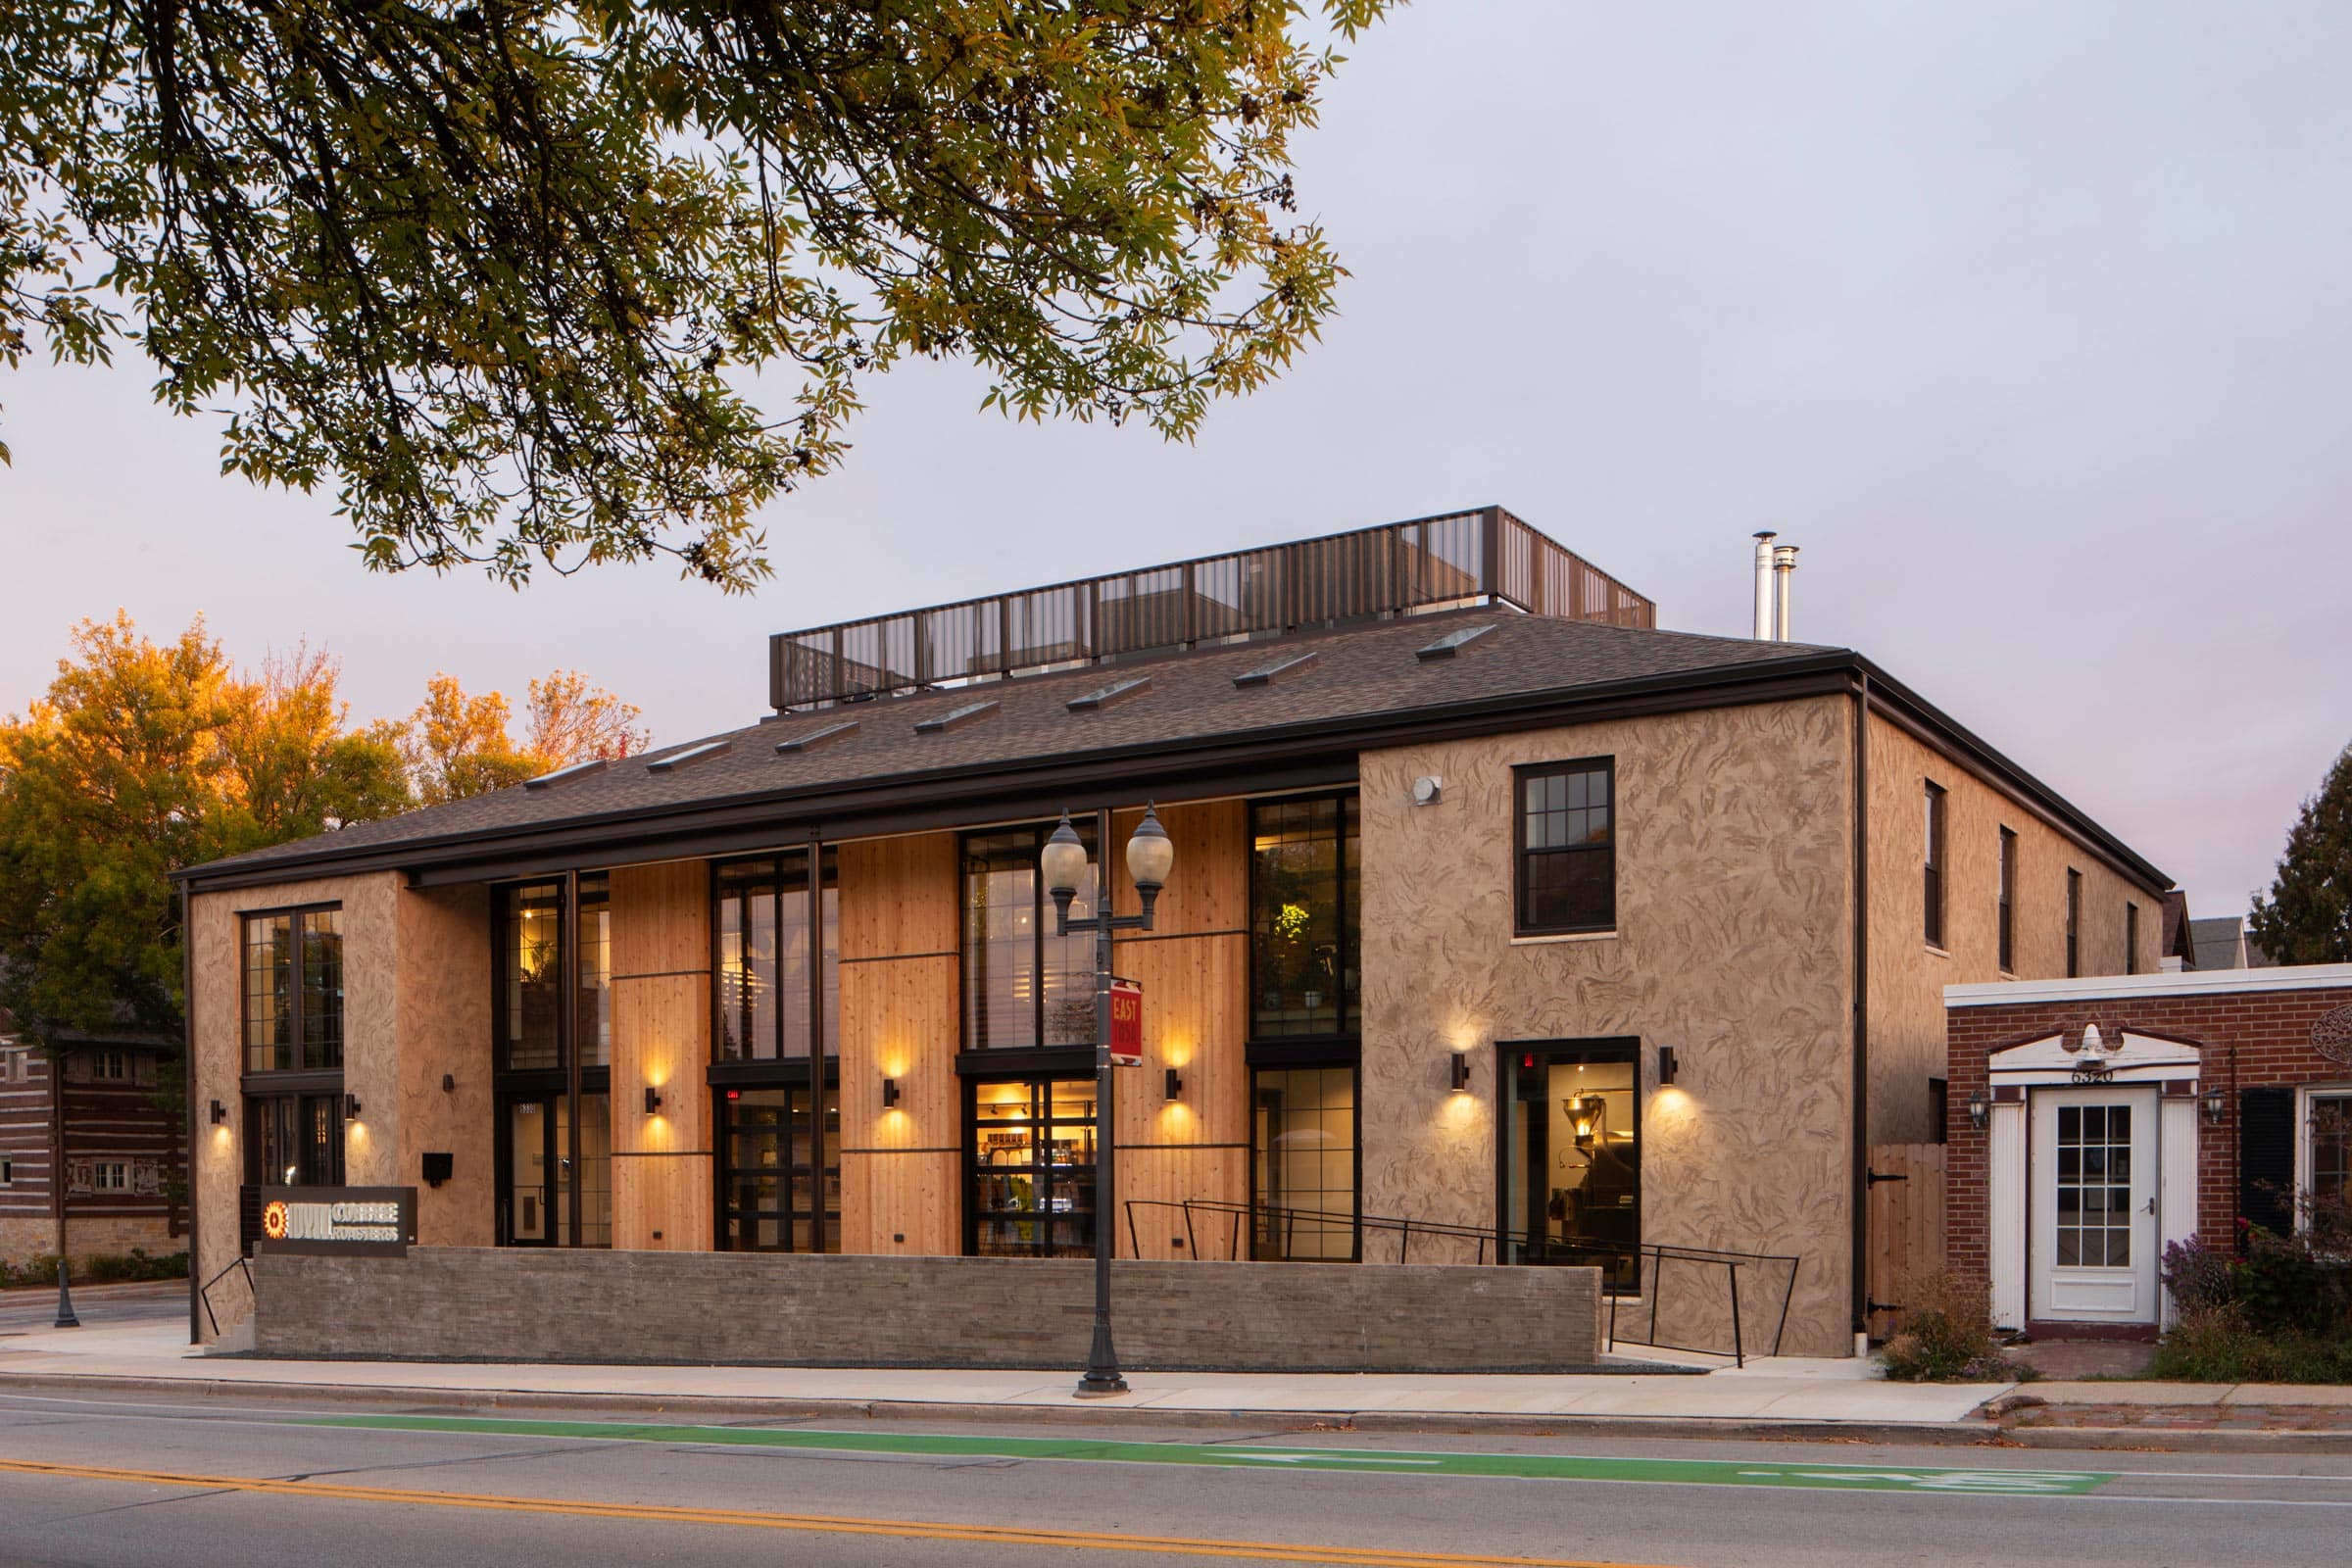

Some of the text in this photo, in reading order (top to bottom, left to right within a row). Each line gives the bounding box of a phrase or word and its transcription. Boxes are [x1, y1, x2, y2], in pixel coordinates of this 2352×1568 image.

[1113, 997, 1136, 1021] EAST
[2072, 1069, 2113, 1083] 6320
[288, 1203, 332, 1240] IDYLL
[332, 1202, 399, 1223] COFFEE
[332, 1226, 399, 1242] ROASTERS
